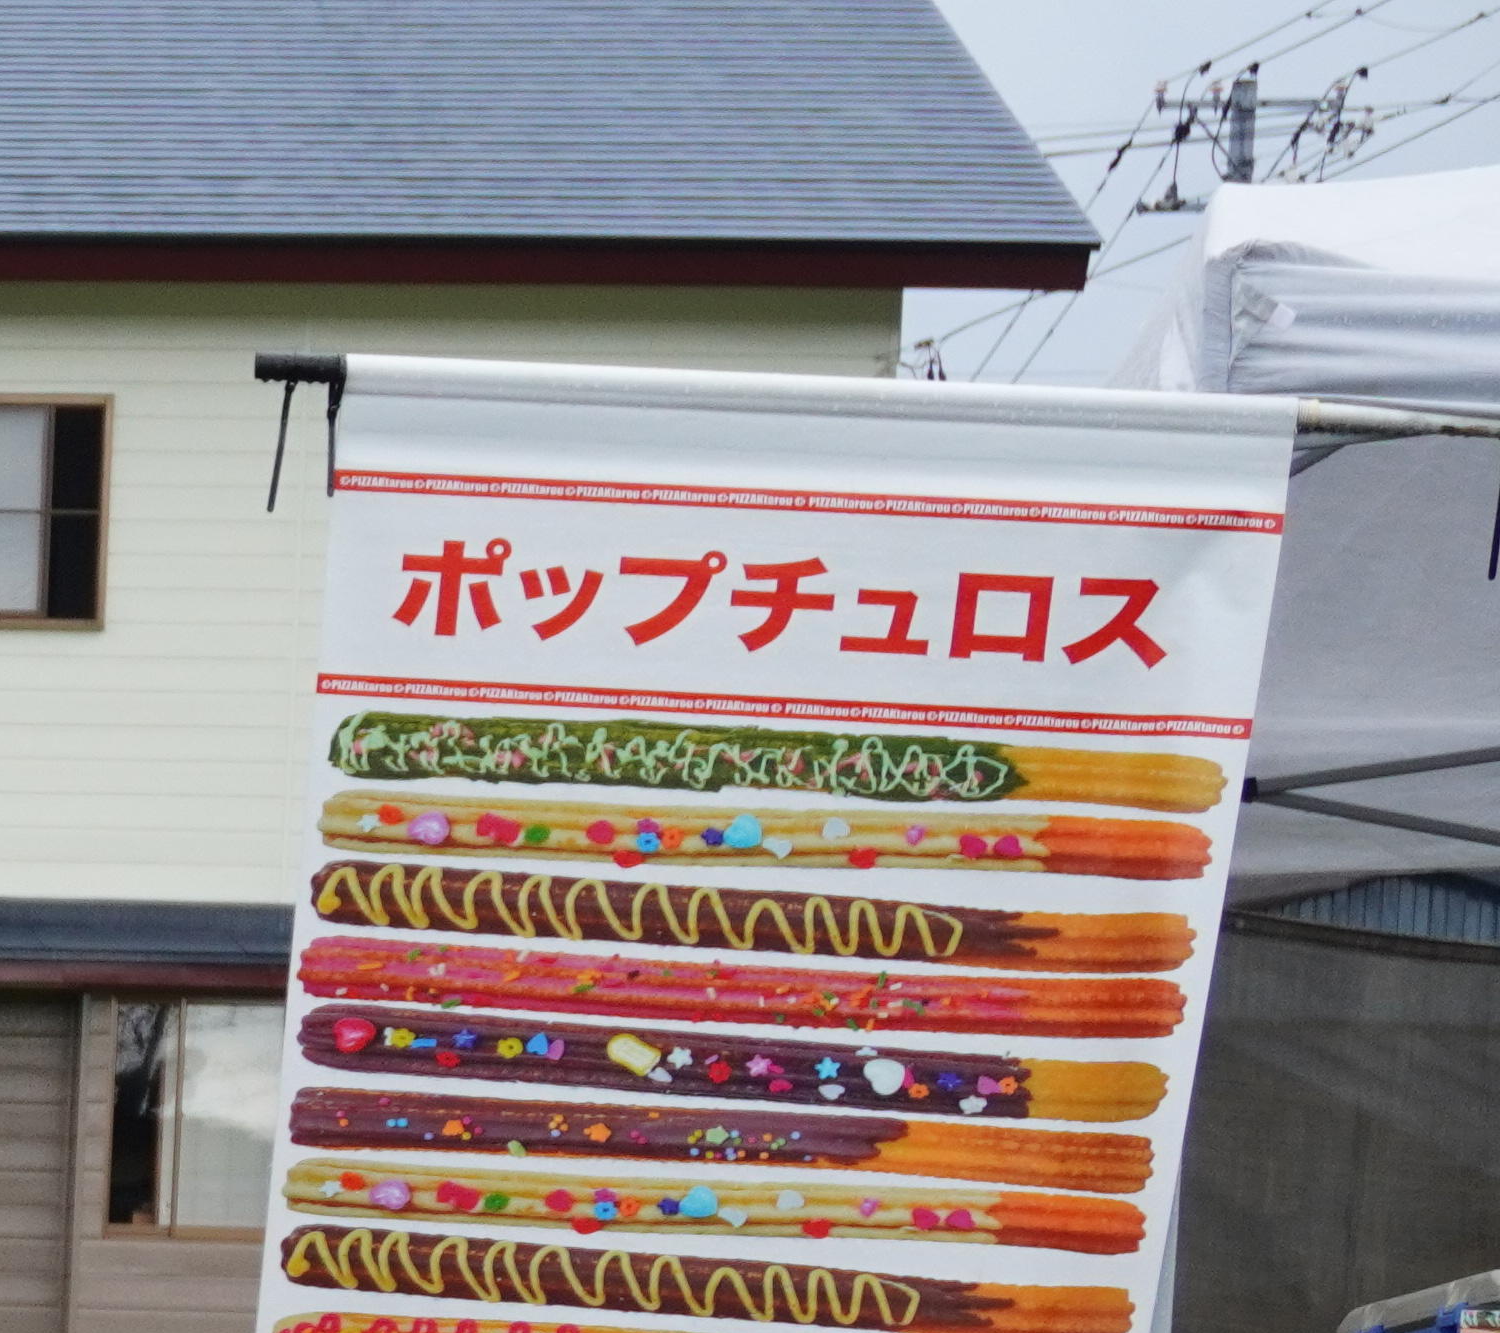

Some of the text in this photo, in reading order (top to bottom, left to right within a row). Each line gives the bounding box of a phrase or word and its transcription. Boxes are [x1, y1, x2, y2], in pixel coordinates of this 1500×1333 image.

[392, 538, 1169, 669] ポップチュロス
